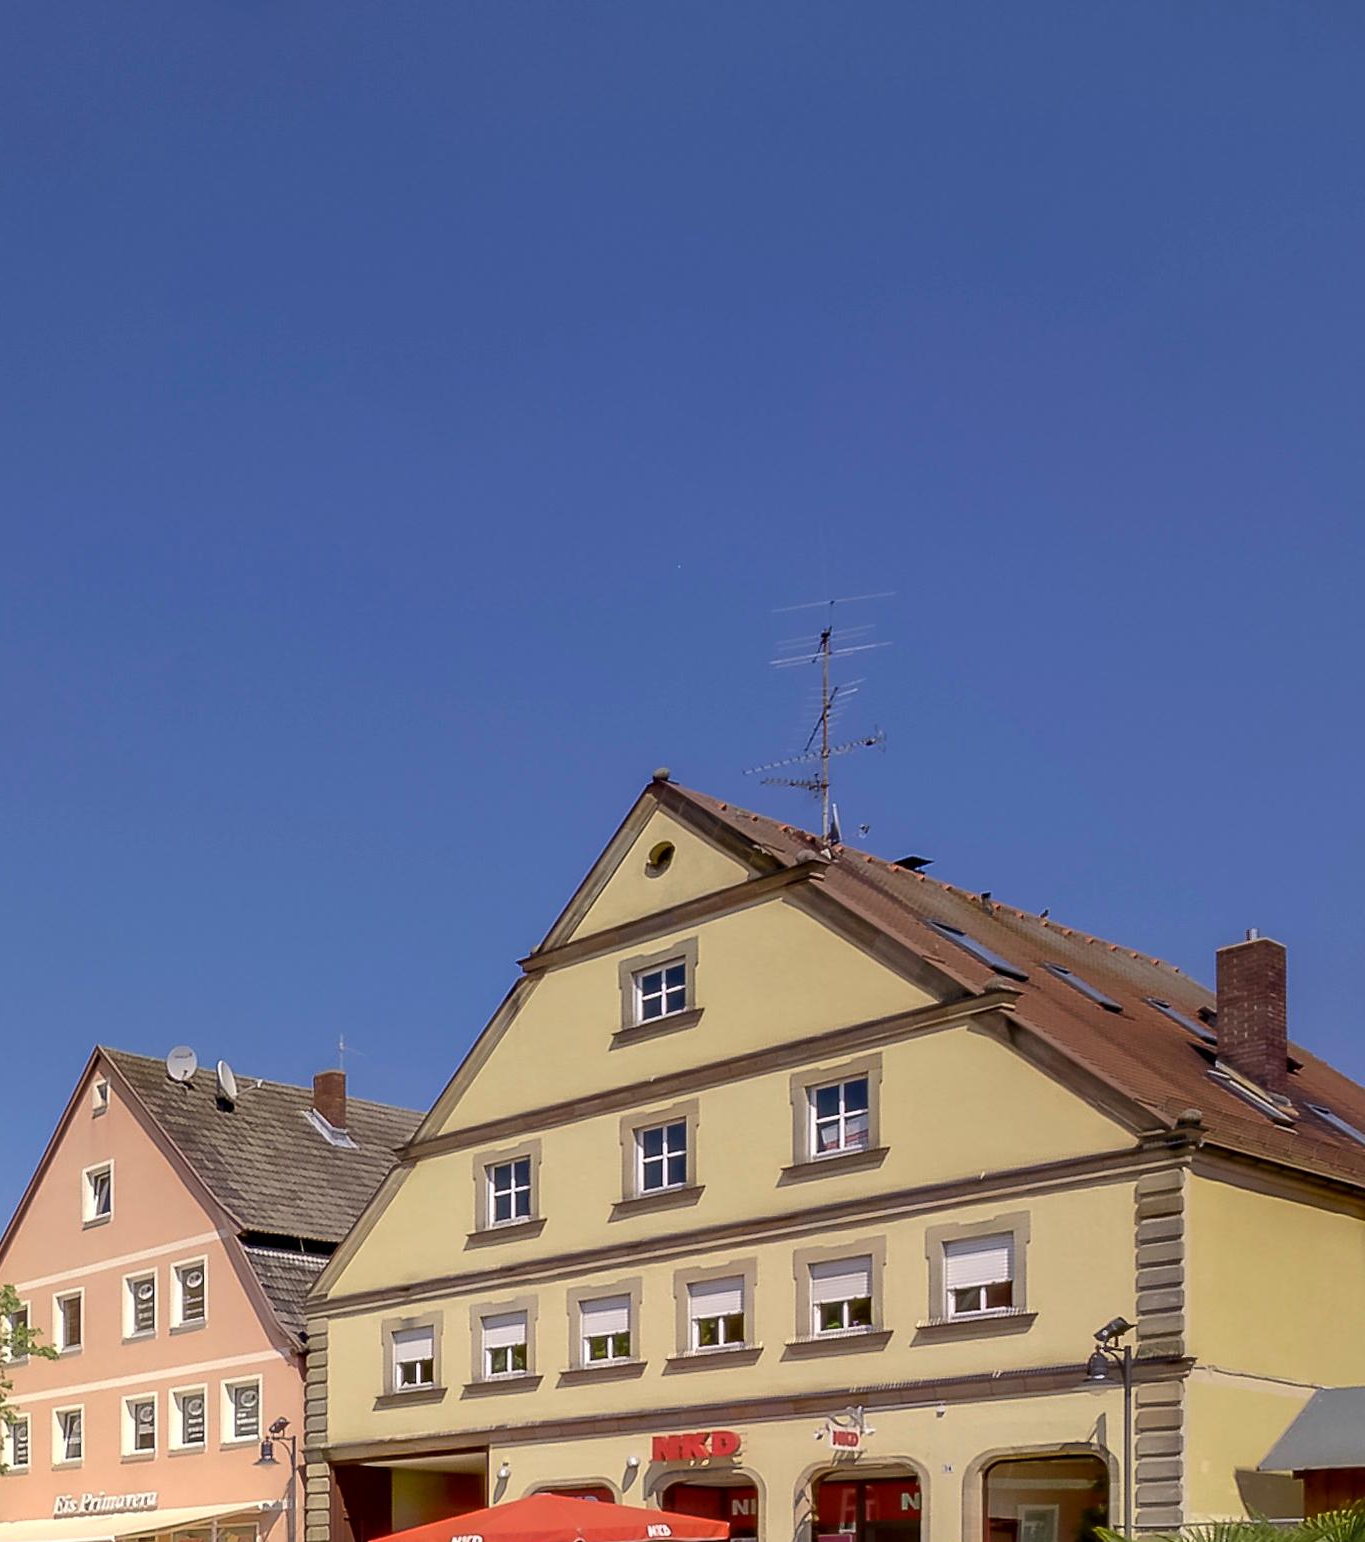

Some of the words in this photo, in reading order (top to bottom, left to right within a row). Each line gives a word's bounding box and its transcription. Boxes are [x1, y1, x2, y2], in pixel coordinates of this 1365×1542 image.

[652, 1430, 741, 1462] NKD
[78, 1491, 158, 1514] Primavera
[647, 1523, 672, 1538] NKD
